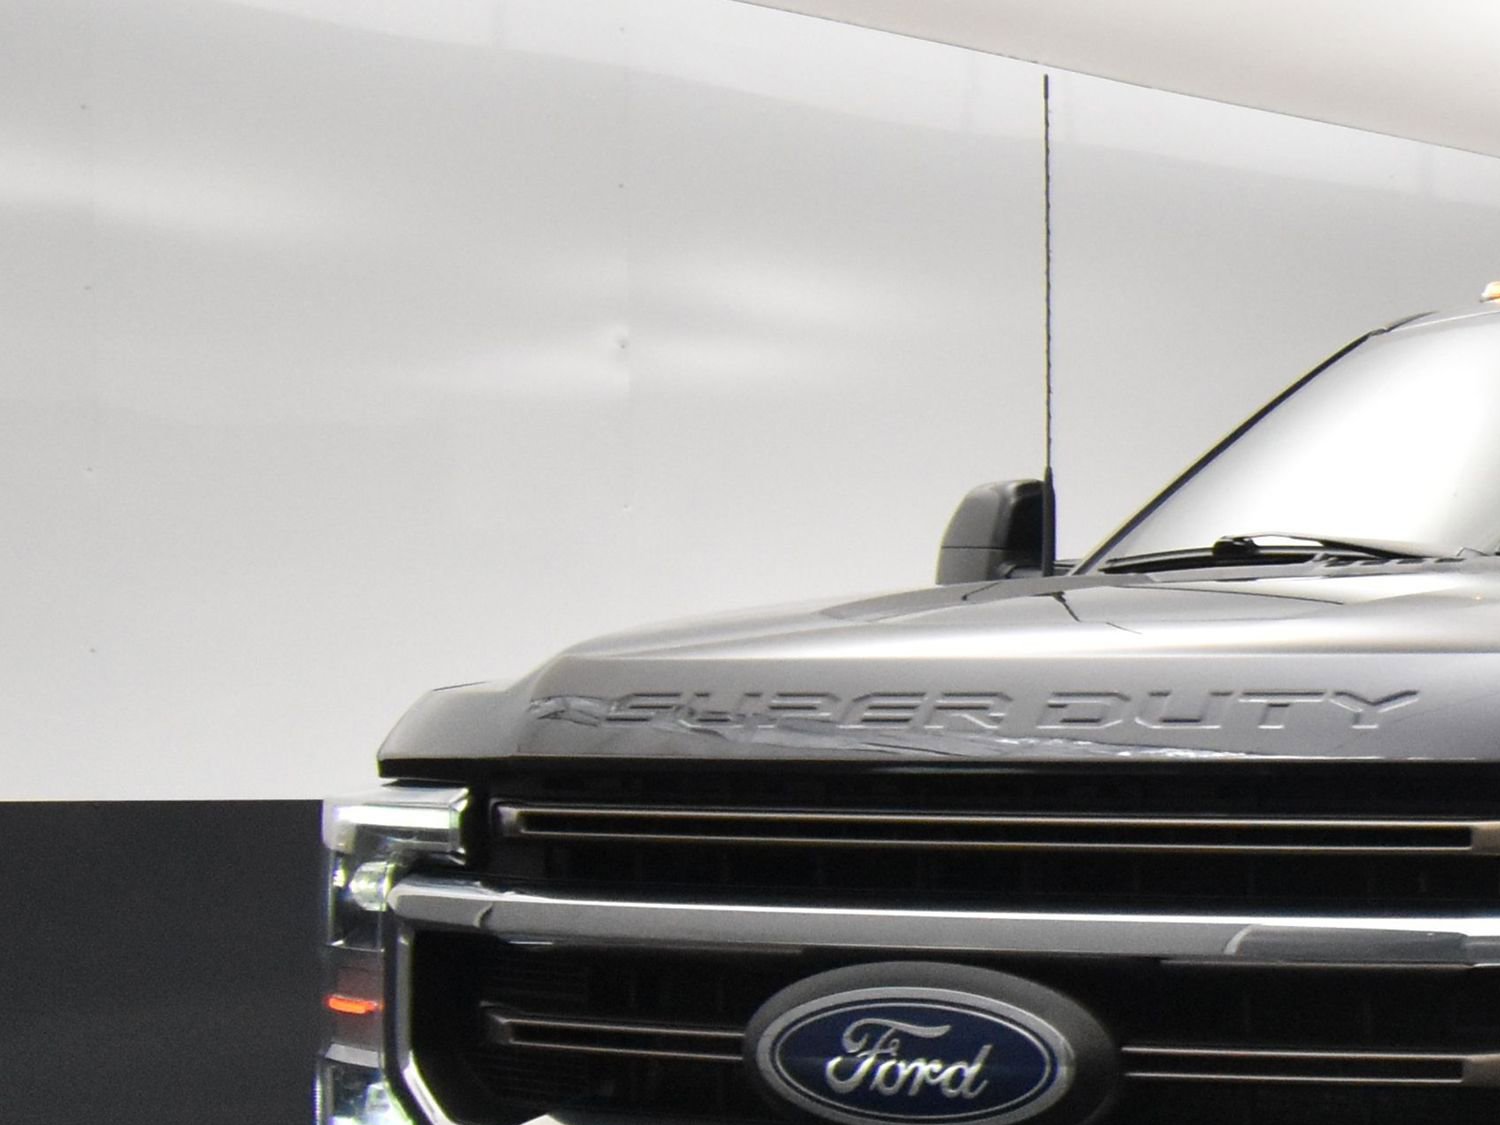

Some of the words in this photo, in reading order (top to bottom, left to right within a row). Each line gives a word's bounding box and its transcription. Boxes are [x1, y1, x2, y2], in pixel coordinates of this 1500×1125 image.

[602, 691, 1014, 730] SUPER
[1036, 690, 1421, 730] DUTY
[825, 1017, 993, 1100] Ford
